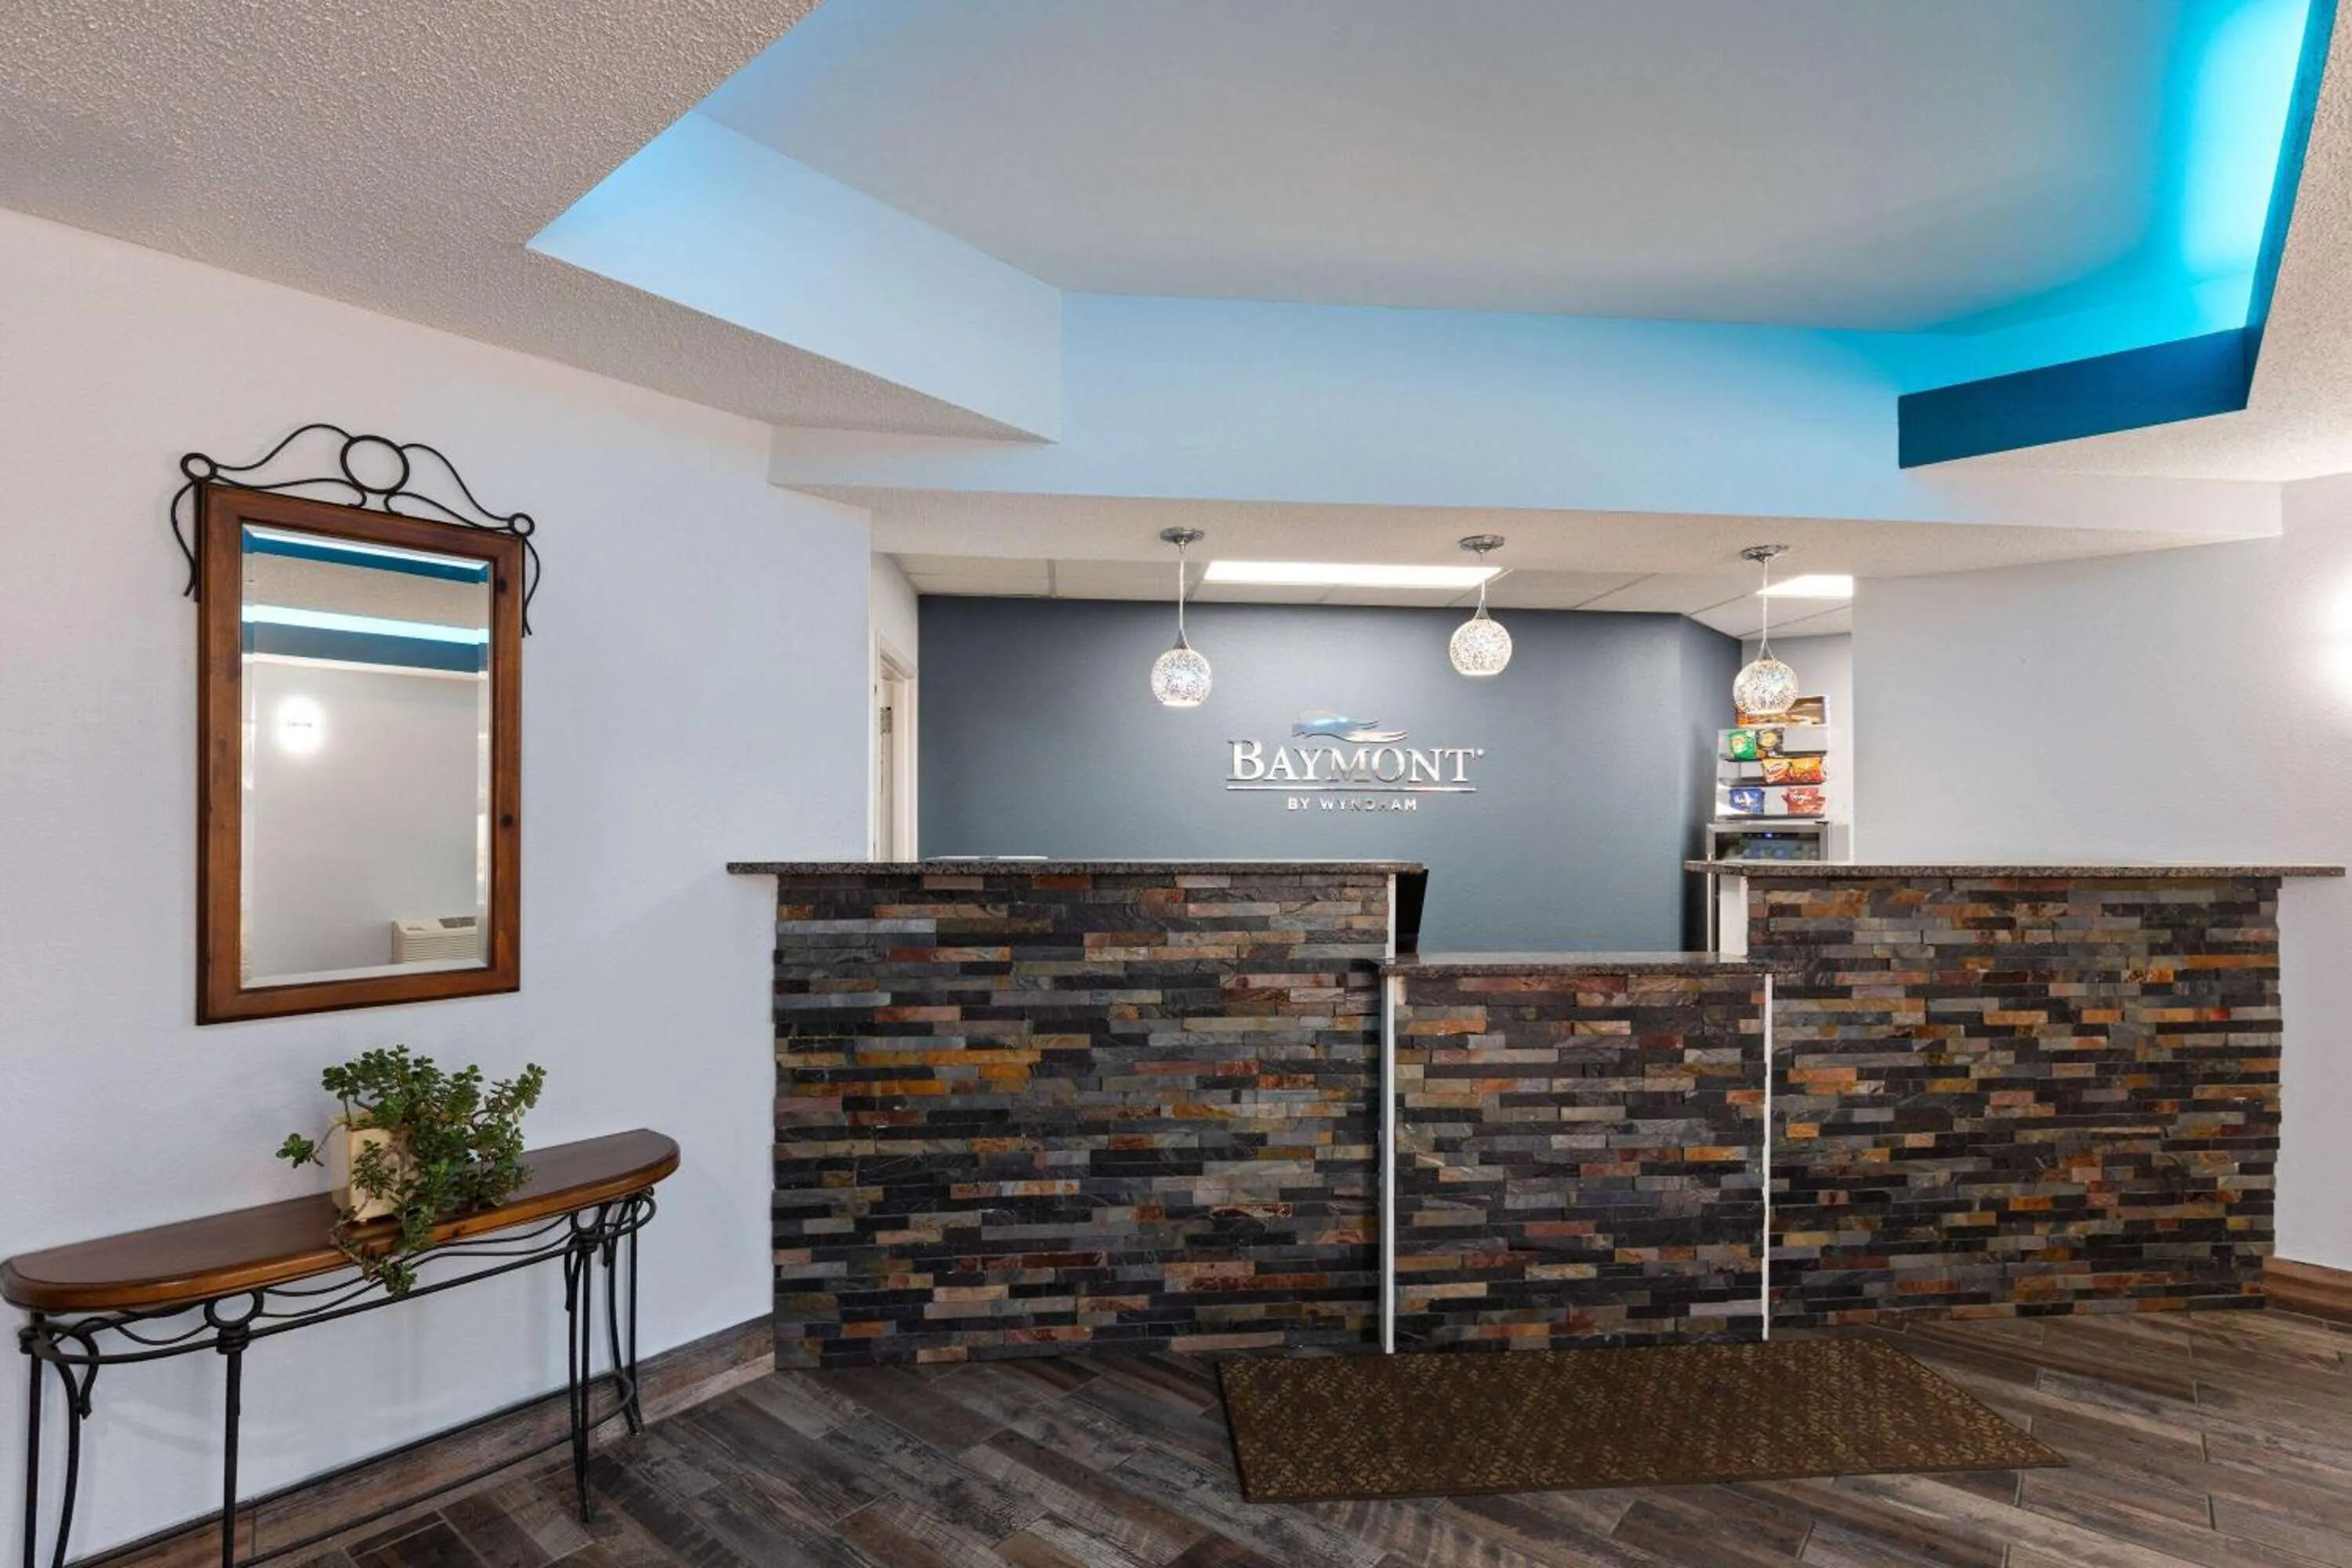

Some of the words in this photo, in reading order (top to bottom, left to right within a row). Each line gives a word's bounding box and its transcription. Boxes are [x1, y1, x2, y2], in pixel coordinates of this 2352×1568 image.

[1227, 739, 1475, 782] BAYMONT
[1288, 797, 1309, 811] BY
[1320, 797, 1417, 811] WYNDAM
